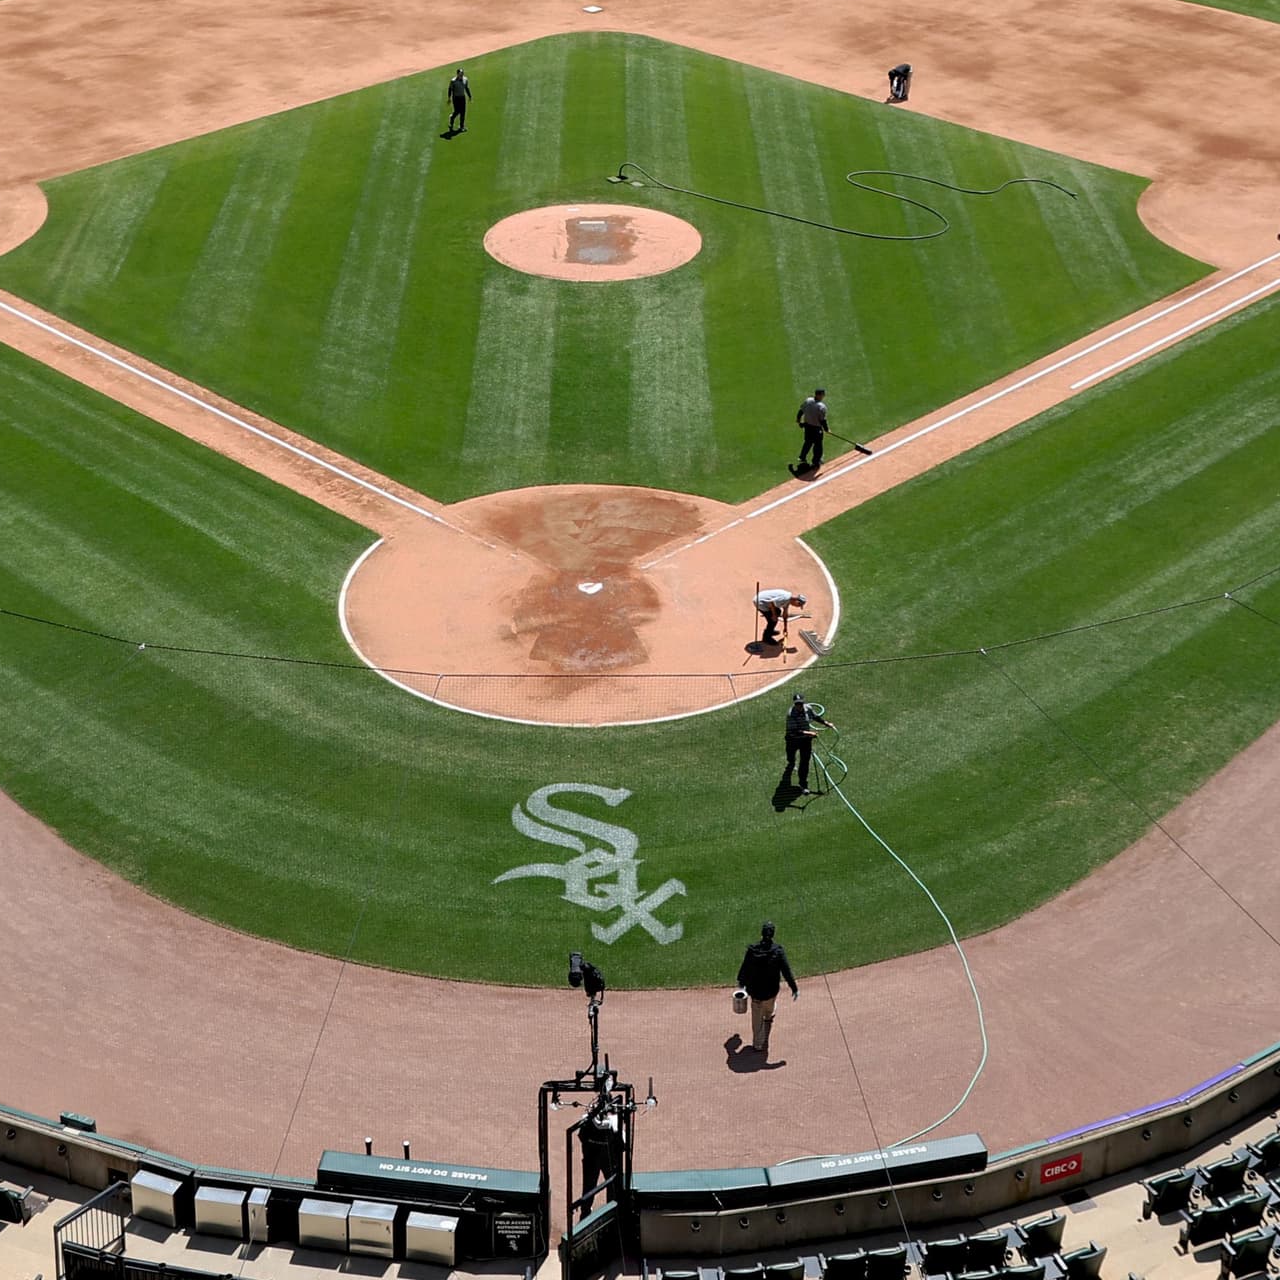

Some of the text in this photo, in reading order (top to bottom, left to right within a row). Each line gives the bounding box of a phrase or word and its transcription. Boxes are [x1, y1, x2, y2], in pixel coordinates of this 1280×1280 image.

[854, 1155, 873, 1164] NOT
[411, 1167, 432, 1176] NOT
[1044, 1163, 1068, 1177] CIBC
[451, 1171, 488, 1181] PLEASE
